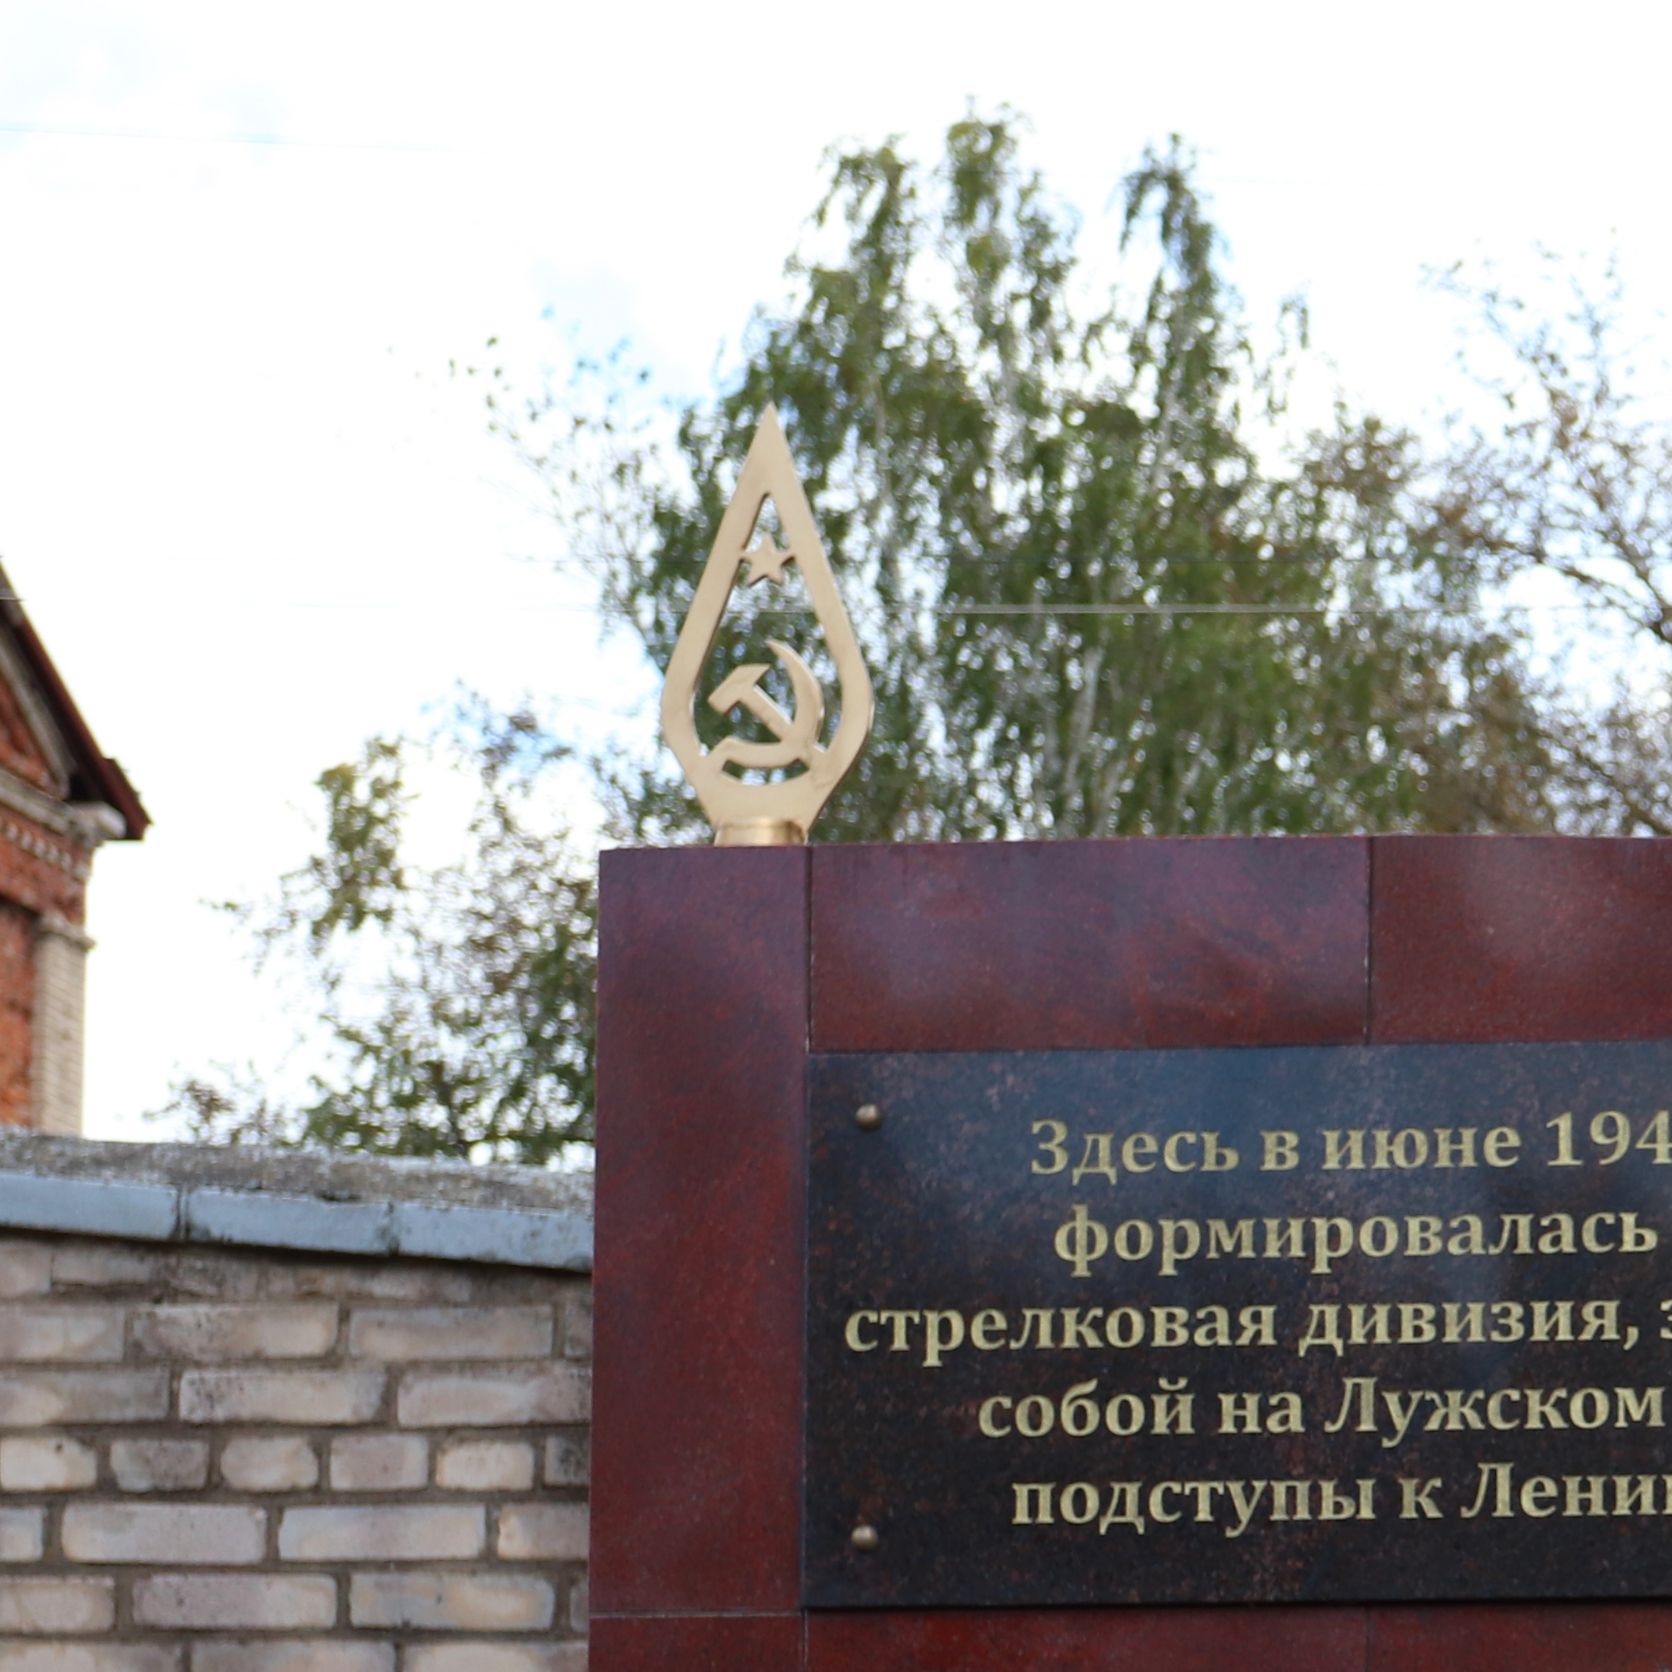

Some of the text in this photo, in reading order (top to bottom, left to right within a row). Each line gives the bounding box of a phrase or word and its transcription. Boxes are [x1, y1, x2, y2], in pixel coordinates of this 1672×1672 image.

[1029, 1117, 1240, 1185] Здесь
[1260, 1130, 1301, 1172] в
[1323, 1125, 1522, 1170] июне
[1053, 1202, 1660, 1278] формировалась
[844, 1304, 1277, 1368] стрелковая
[1297, 1299, 1640, 1358] дивизия,
[977, 1376, 1195, 1439] собой
[1217, 1391, 1304, 1435] на
[1323, 1376, 1665, 1449] Лужском
[1011, 1478, 1376, 1539] подступы
[1398, 1477, 1443, 1520] к
